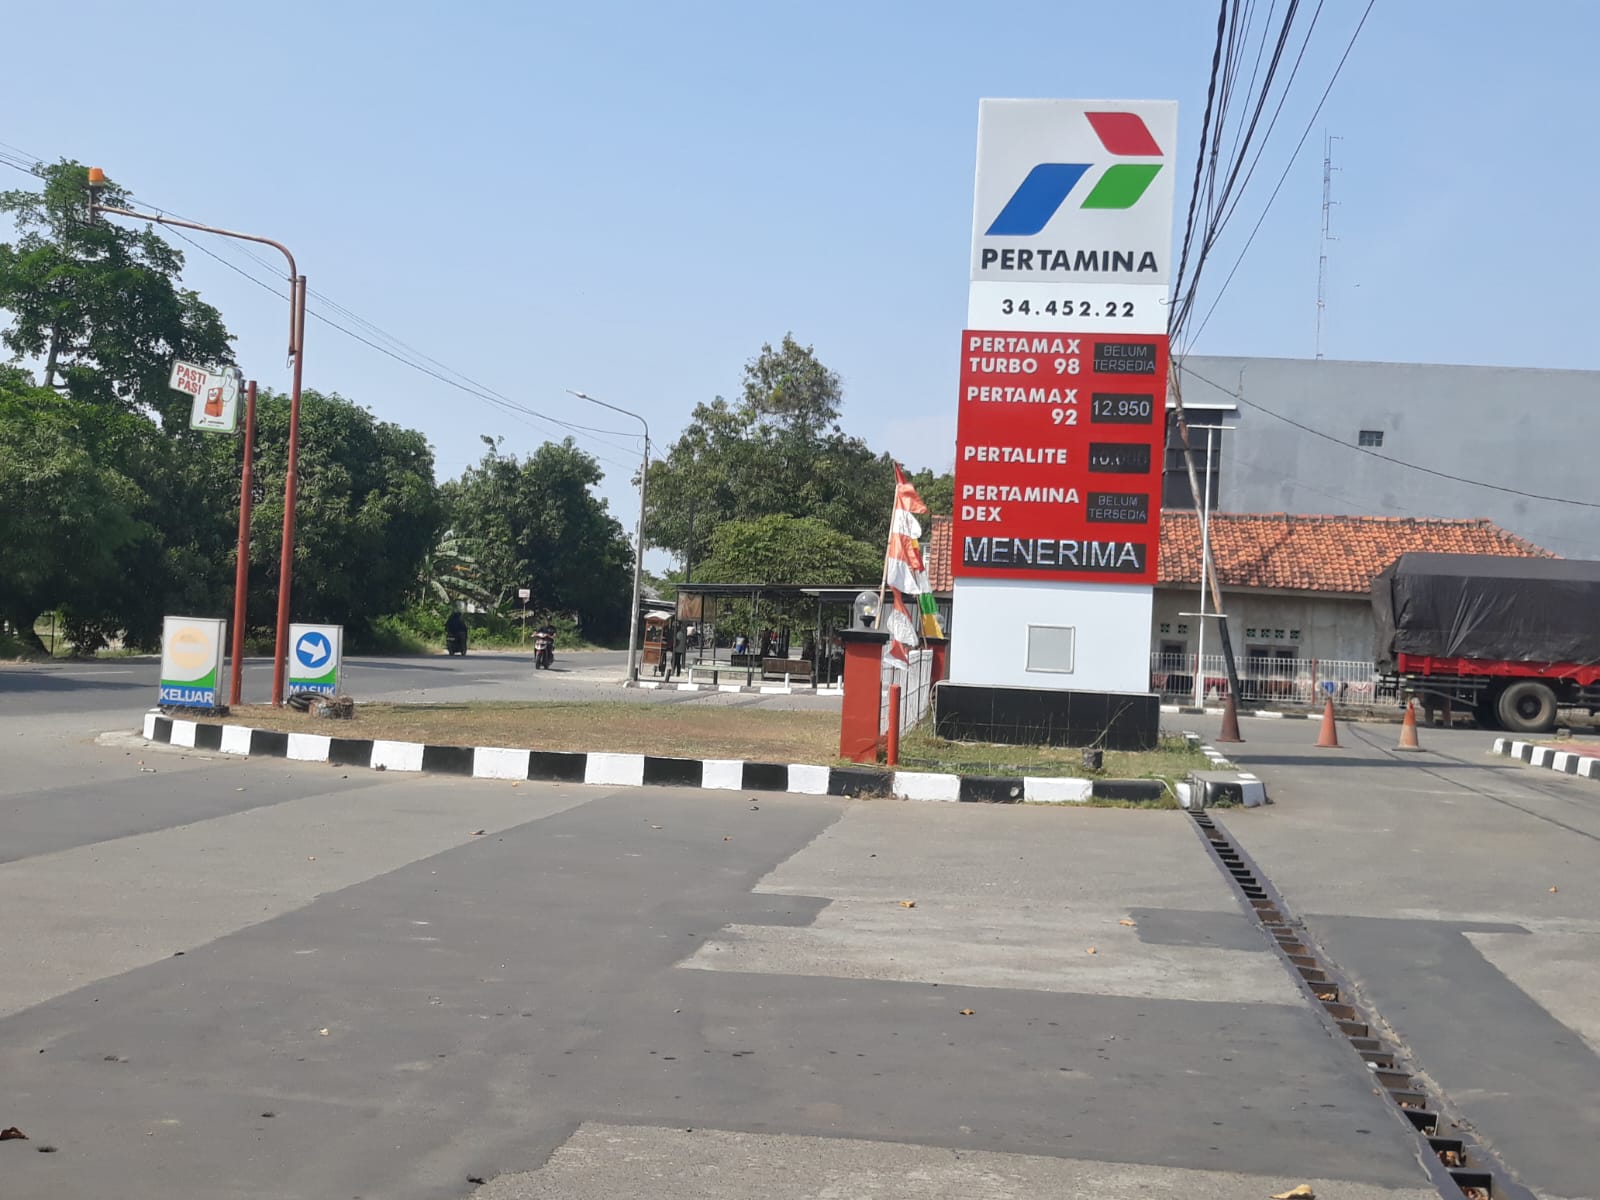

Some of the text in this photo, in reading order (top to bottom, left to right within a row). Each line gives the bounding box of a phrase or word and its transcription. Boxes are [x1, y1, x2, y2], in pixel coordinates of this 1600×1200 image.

[981, 249, 1158, 272] PERTAMINA
[1002, 299, 1135, 318] 34.452.22
[969, 337, 1081, 355] PERTAMAX
[1103, 345, 1147, 357] BELUM
[176, 364, 207, 385] PASTI
[969, 357, 1081, 375] TURBO 98
[1094, 359, 1155, 372] TERSEDIA
[967, 386, 1078, 404] PERTAMAX
[1051, 408, 1078, 426] 92
[1093, 400, 1150, 417] 12.950
[964, 446, 1068, 465] PERTALITE
[962, 485, 1080, 504] PERTAMINA
[1098, 495, 1138, 507] BELUM
[961, 506, 1002, 523] DEX
[1088, 508, 1146, 521] TERSEDIA
[964, 536, 1140, 569] MENERIMA
[160, 688, 214, 704] KELUAR
